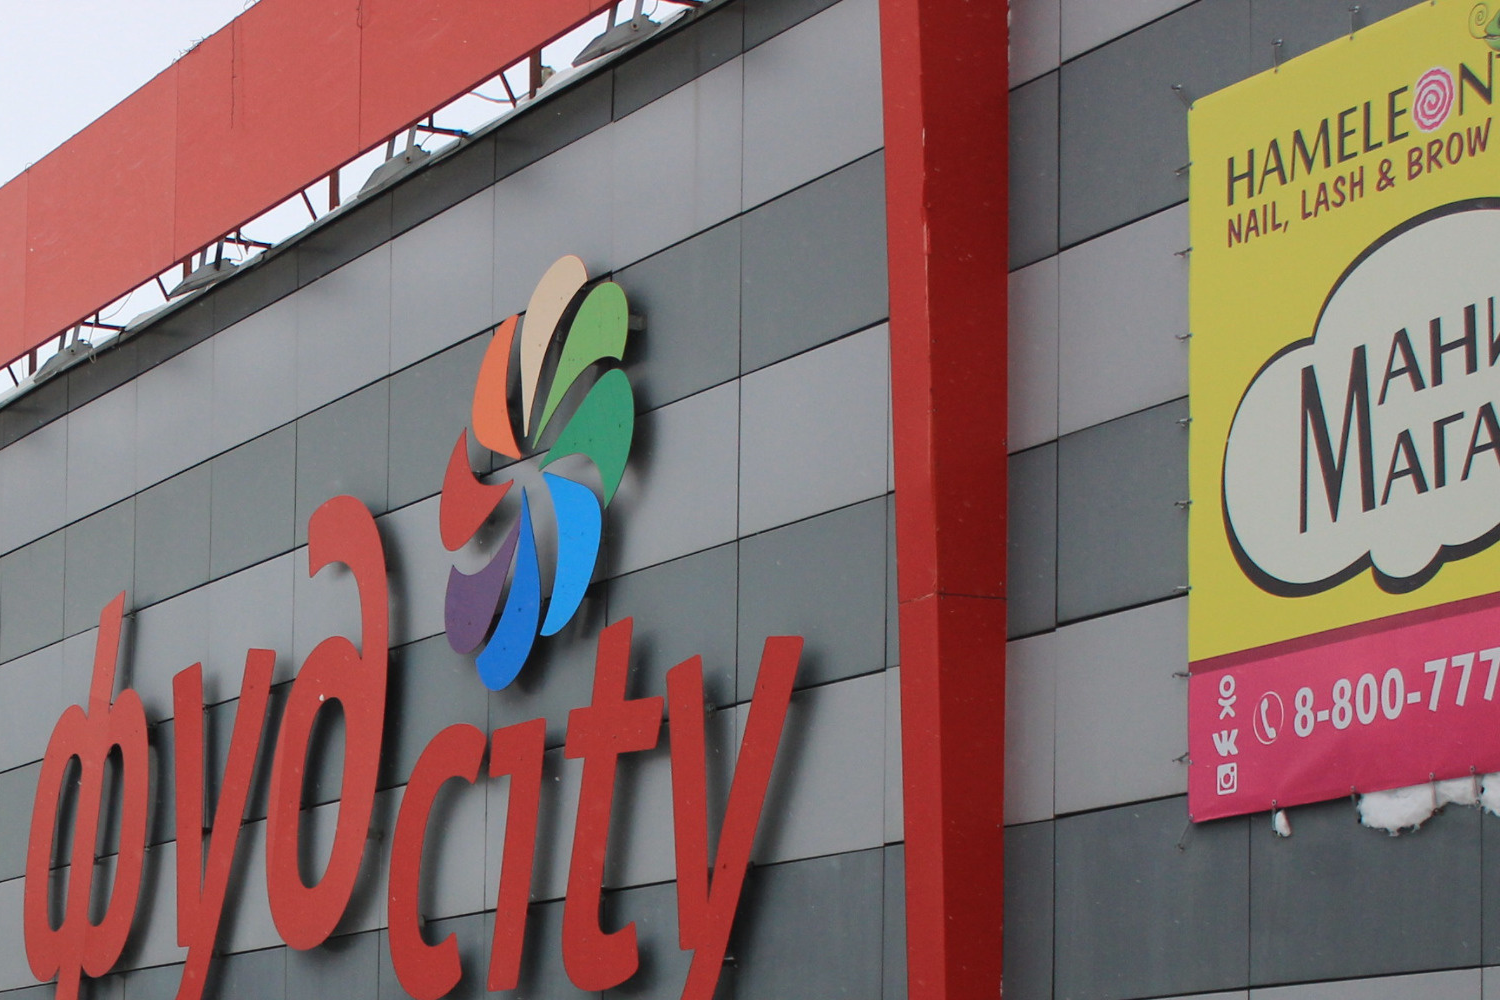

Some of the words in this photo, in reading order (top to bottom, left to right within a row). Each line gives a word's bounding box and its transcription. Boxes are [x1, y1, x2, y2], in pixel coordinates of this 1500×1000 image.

[1227, 52, 1500, 206] HAMELEON
[1228, 201, 1290, 248] NAIL,
[1301, 165, 1364, 220] LASH
[1376, 158, 1396, 192] &
[1407, 117, 1492, 181] BROW
